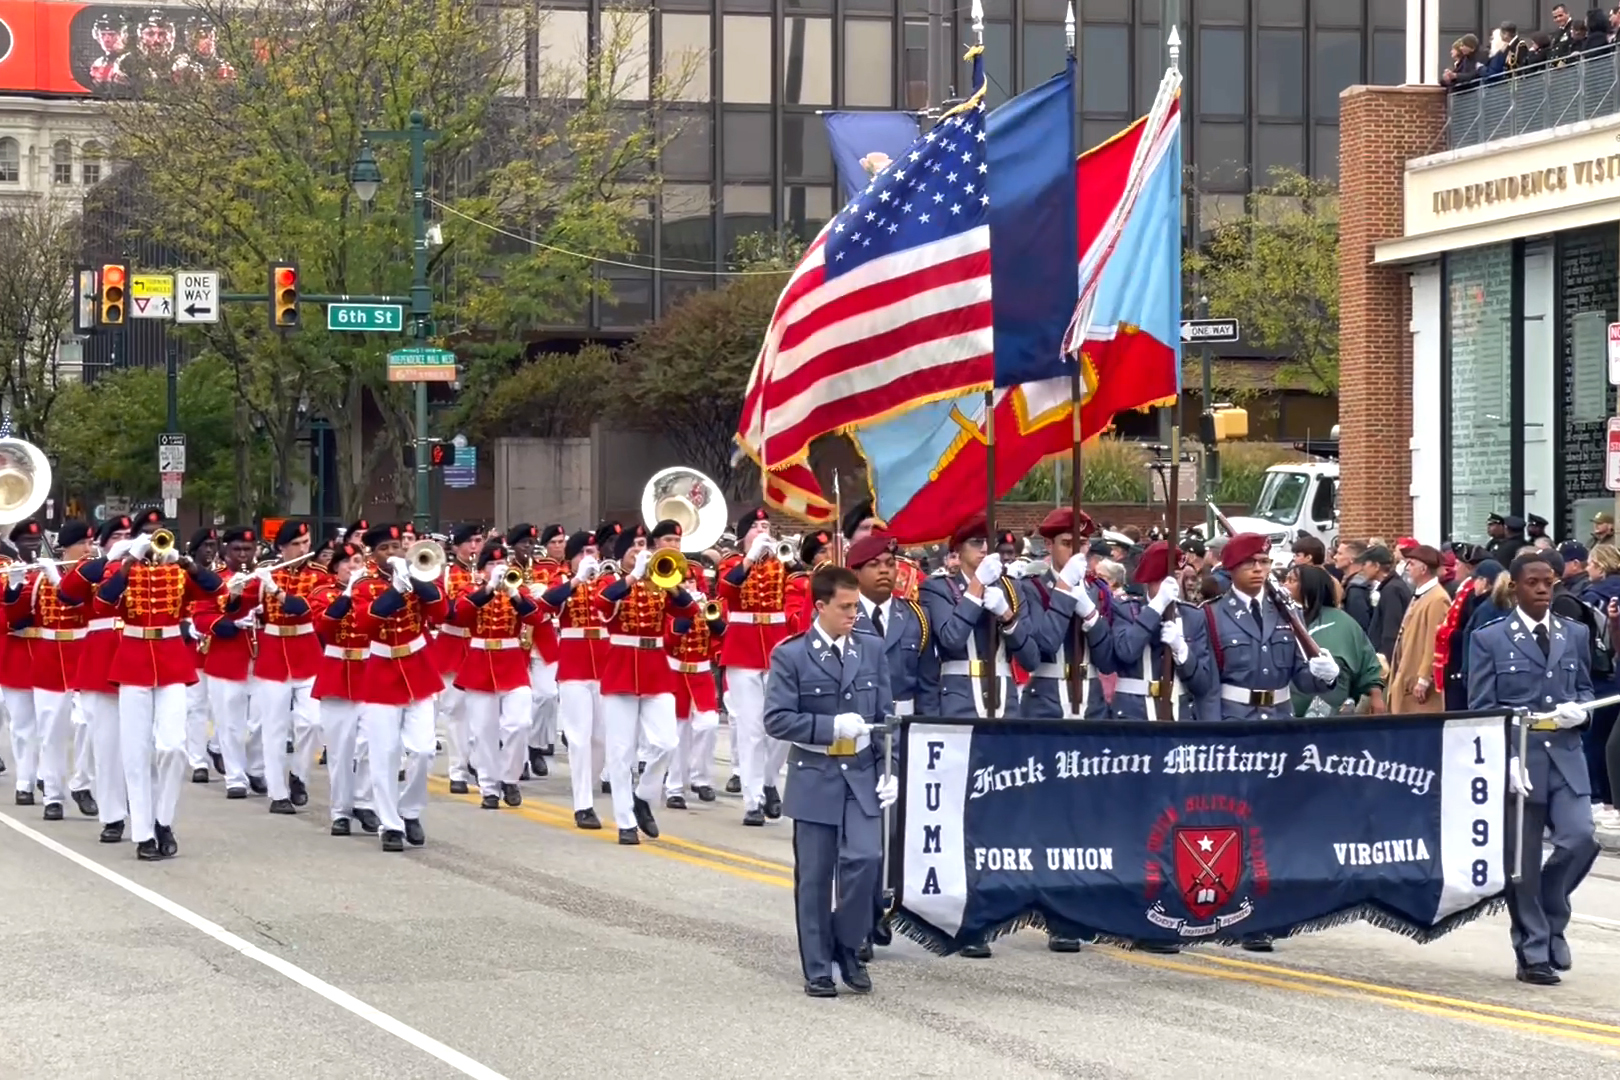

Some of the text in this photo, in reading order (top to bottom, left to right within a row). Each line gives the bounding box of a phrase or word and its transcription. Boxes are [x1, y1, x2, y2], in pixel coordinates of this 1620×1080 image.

[1432, 166, 1567, 213] INDEPENDENCE
[185, 276, 210, 288] ONE
[185, 290, 211, 301] WAY
[338, 310, 392, 324] 6th St
[1192, 326, 1230, 335] ONE WAY
[390, 354, 455, 364] INDEPENDENCE MALL WEST
[970, 744, 1436, 800] Fork Union Military Academy
[1333, 838, 1431, 865] VIRGINIA
[974, 848, 1114, 871] FORK UNION
